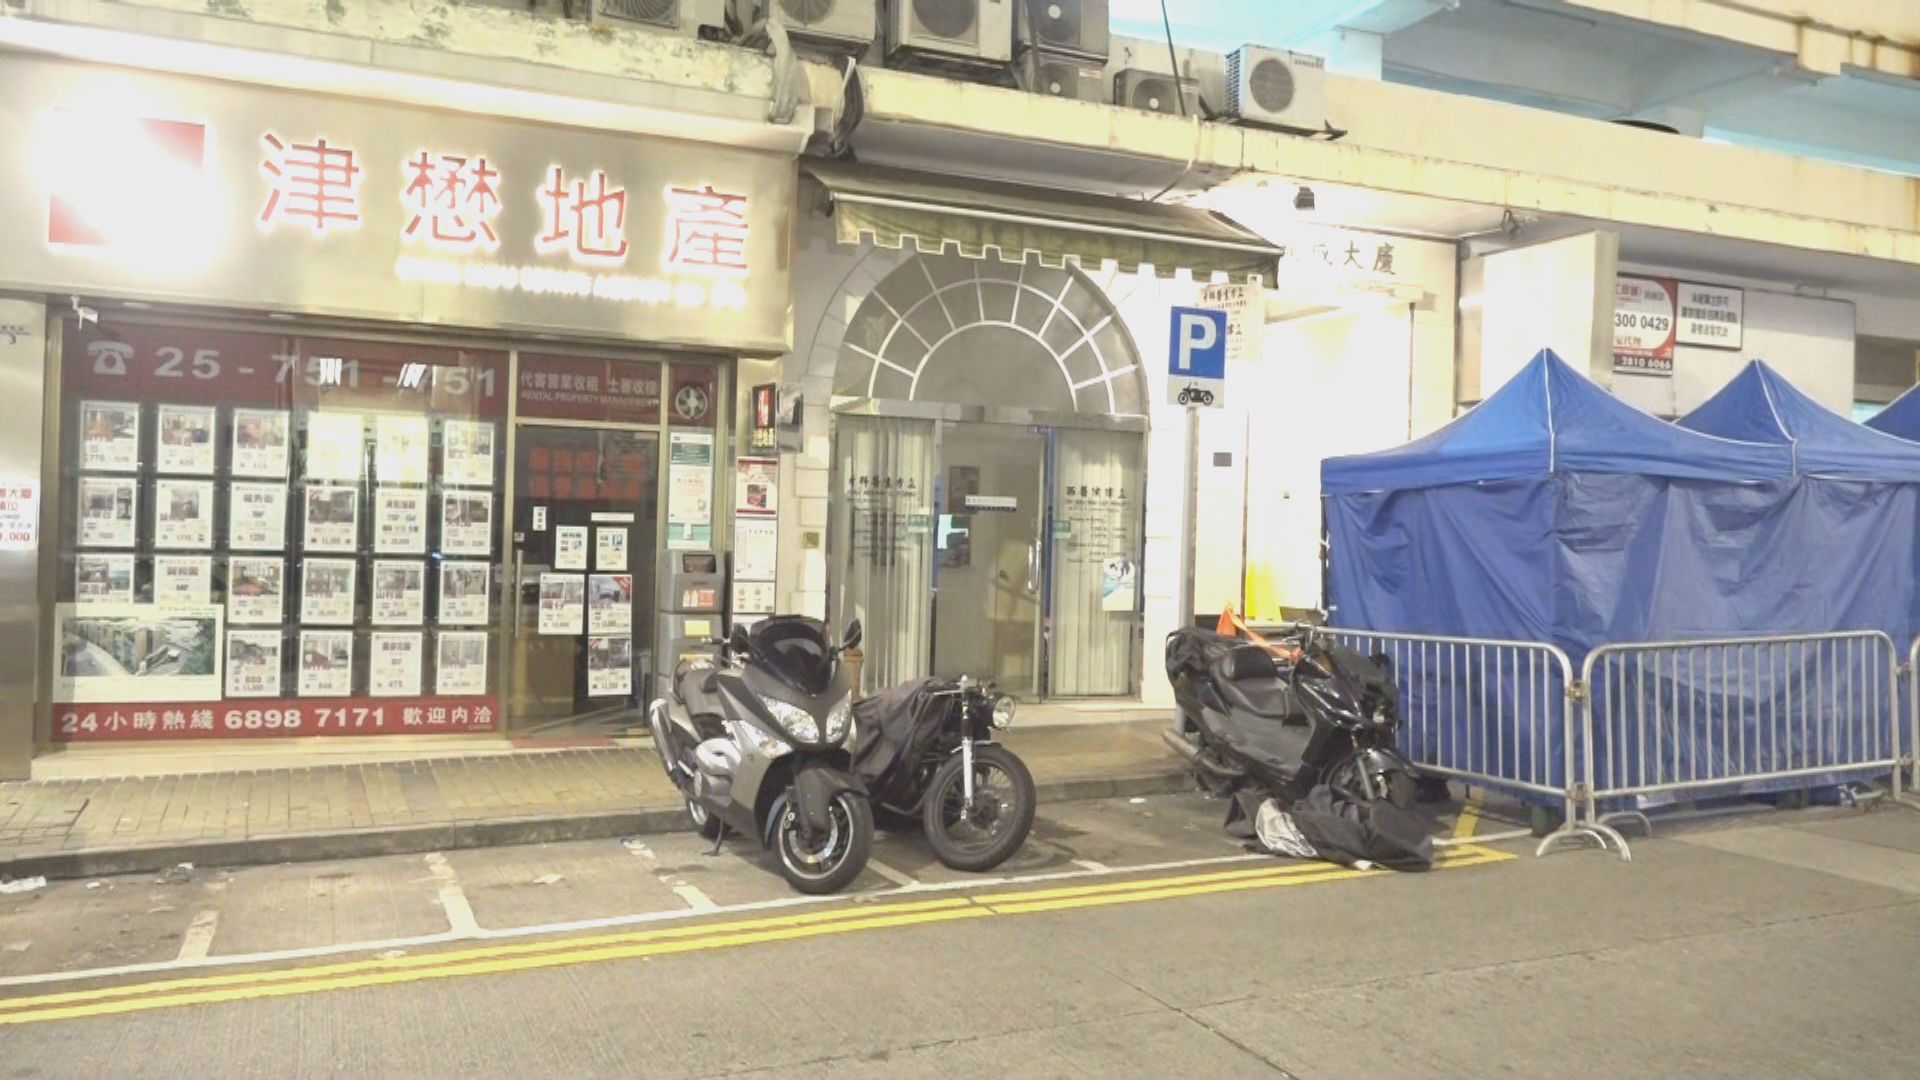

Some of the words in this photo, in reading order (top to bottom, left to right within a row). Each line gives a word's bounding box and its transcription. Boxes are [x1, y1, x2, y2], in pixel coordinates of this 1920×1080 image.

[258, 132, 749, 271] 津懋地產
[1640, 316, 1669, 331] 0429
[1178, 313, 1216, 370] P
[154, 346, 220, 379] 25
[555, 393, 599, 404] PROPERTY
[224, 709, 301, 730] 6898
[315, 708, 385, 728] 7171
